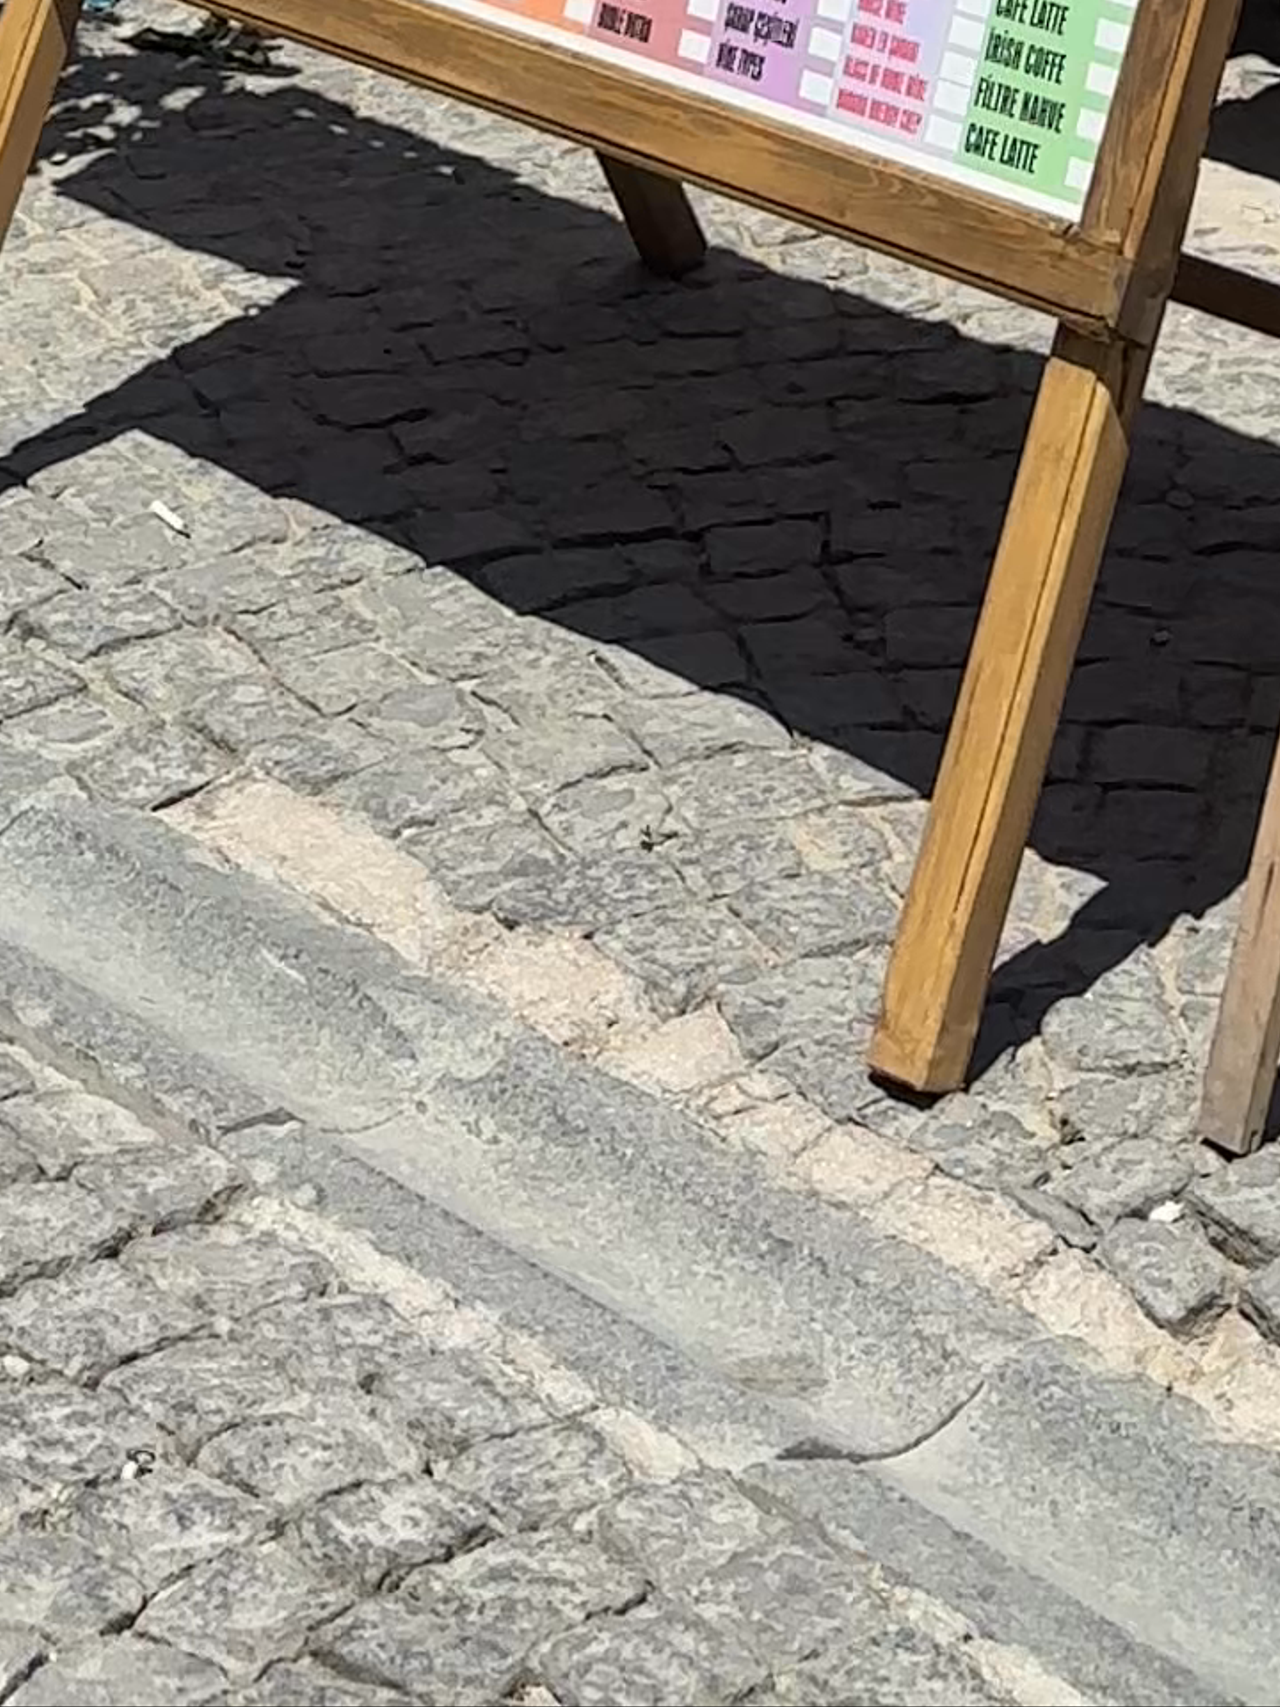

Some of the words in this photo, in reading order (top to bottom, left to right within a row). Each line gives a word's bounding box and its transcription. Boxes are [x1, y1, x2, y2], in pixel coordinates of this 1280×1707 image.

[1023, 43, 1067, 86] COFFE
[964, 122, 1001, 162] CAFE
[998, 133, 1041, 175] LATTE
